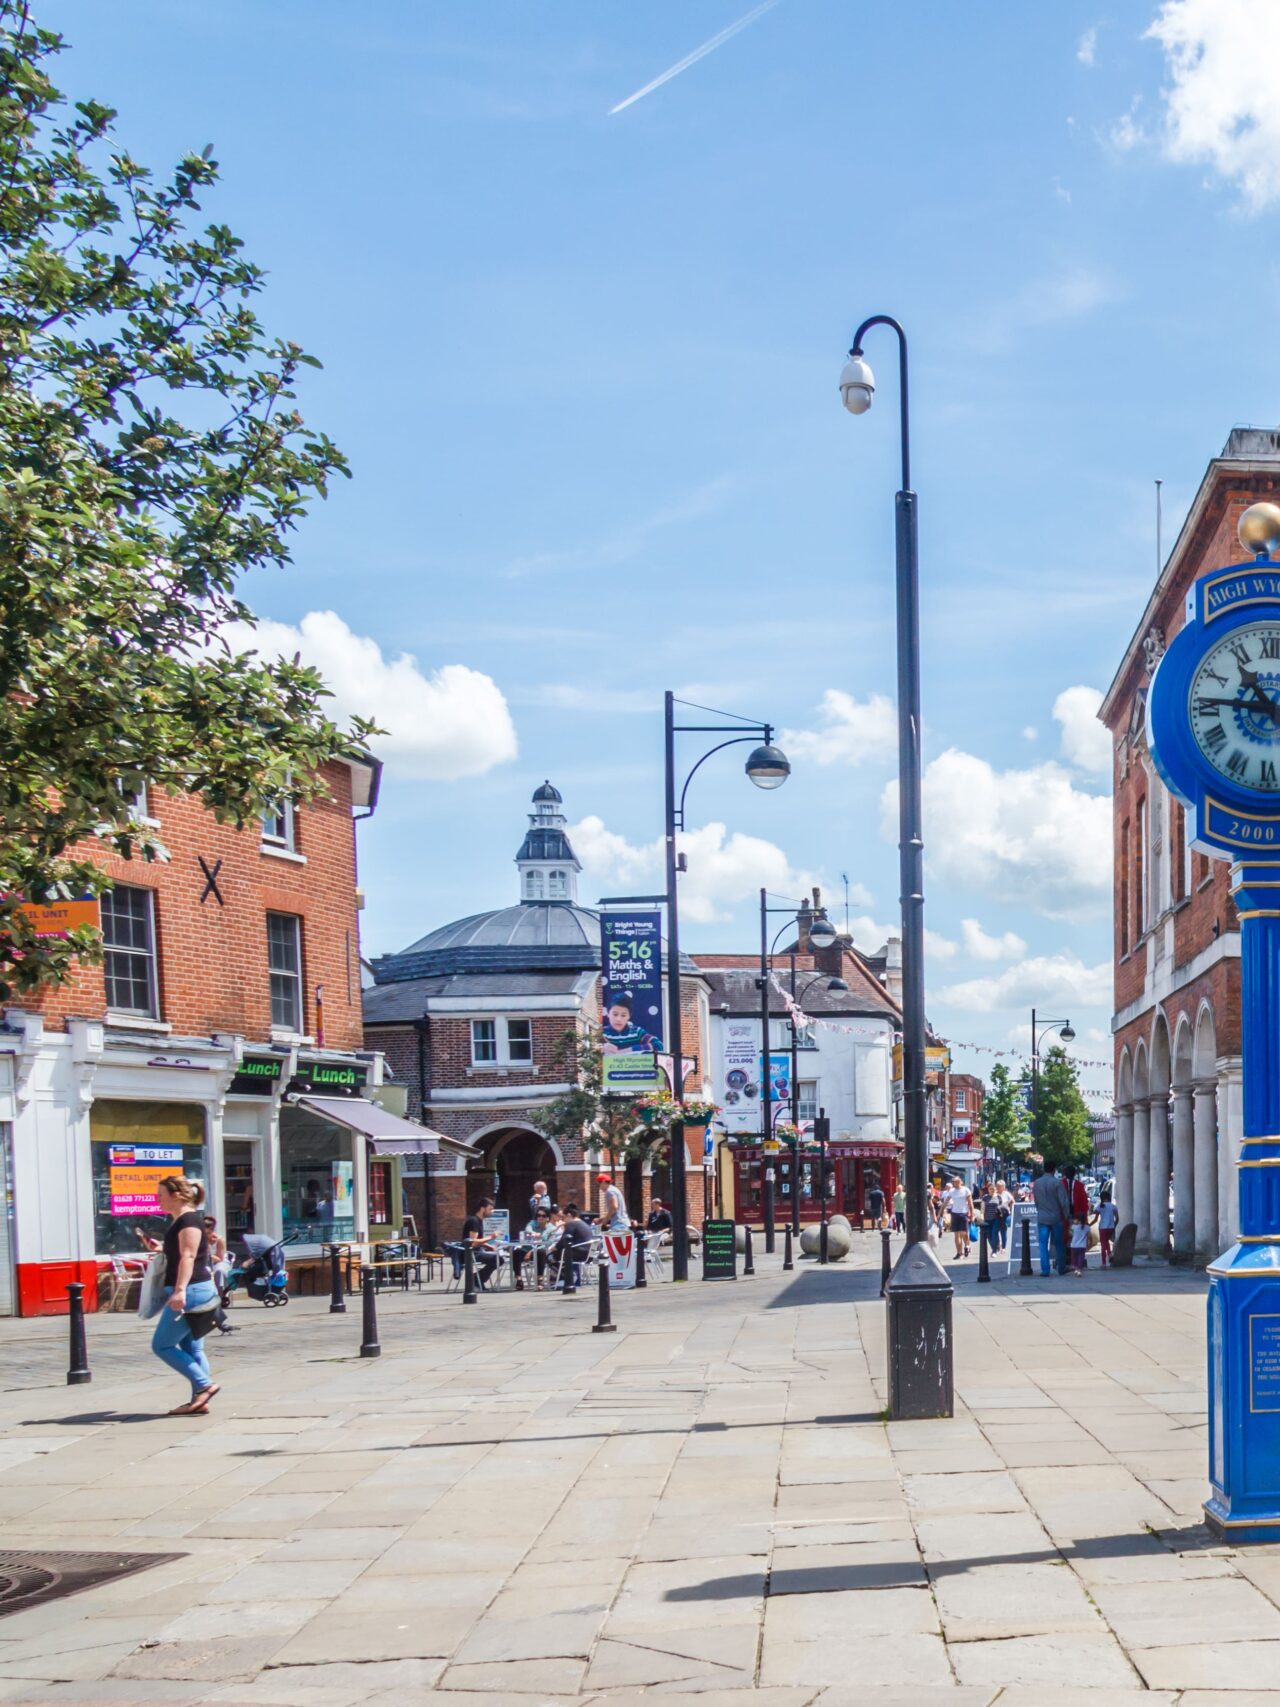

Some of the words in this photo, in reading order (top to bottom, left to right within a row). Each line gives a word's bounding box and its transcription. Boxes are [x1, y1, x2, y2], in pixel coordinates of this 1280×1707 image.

[1208, 581, 1248, 607] HIGH
[1259, 637, 1280, 659] XII
[1229, 821, 1275, 840] 2000
[608, 941, 652, 960] 5-16
[609, 959, 642, 970] Maths
[644, 959, 654, 969] &
[609, 970, 647, 983] English
[238, 1061, 280, 1076] Lunch
[312, 1064, 355, 1084] Lunch
[143, 1150, 155, 1159] TO
[158, 1150, 174, 1159] LET
